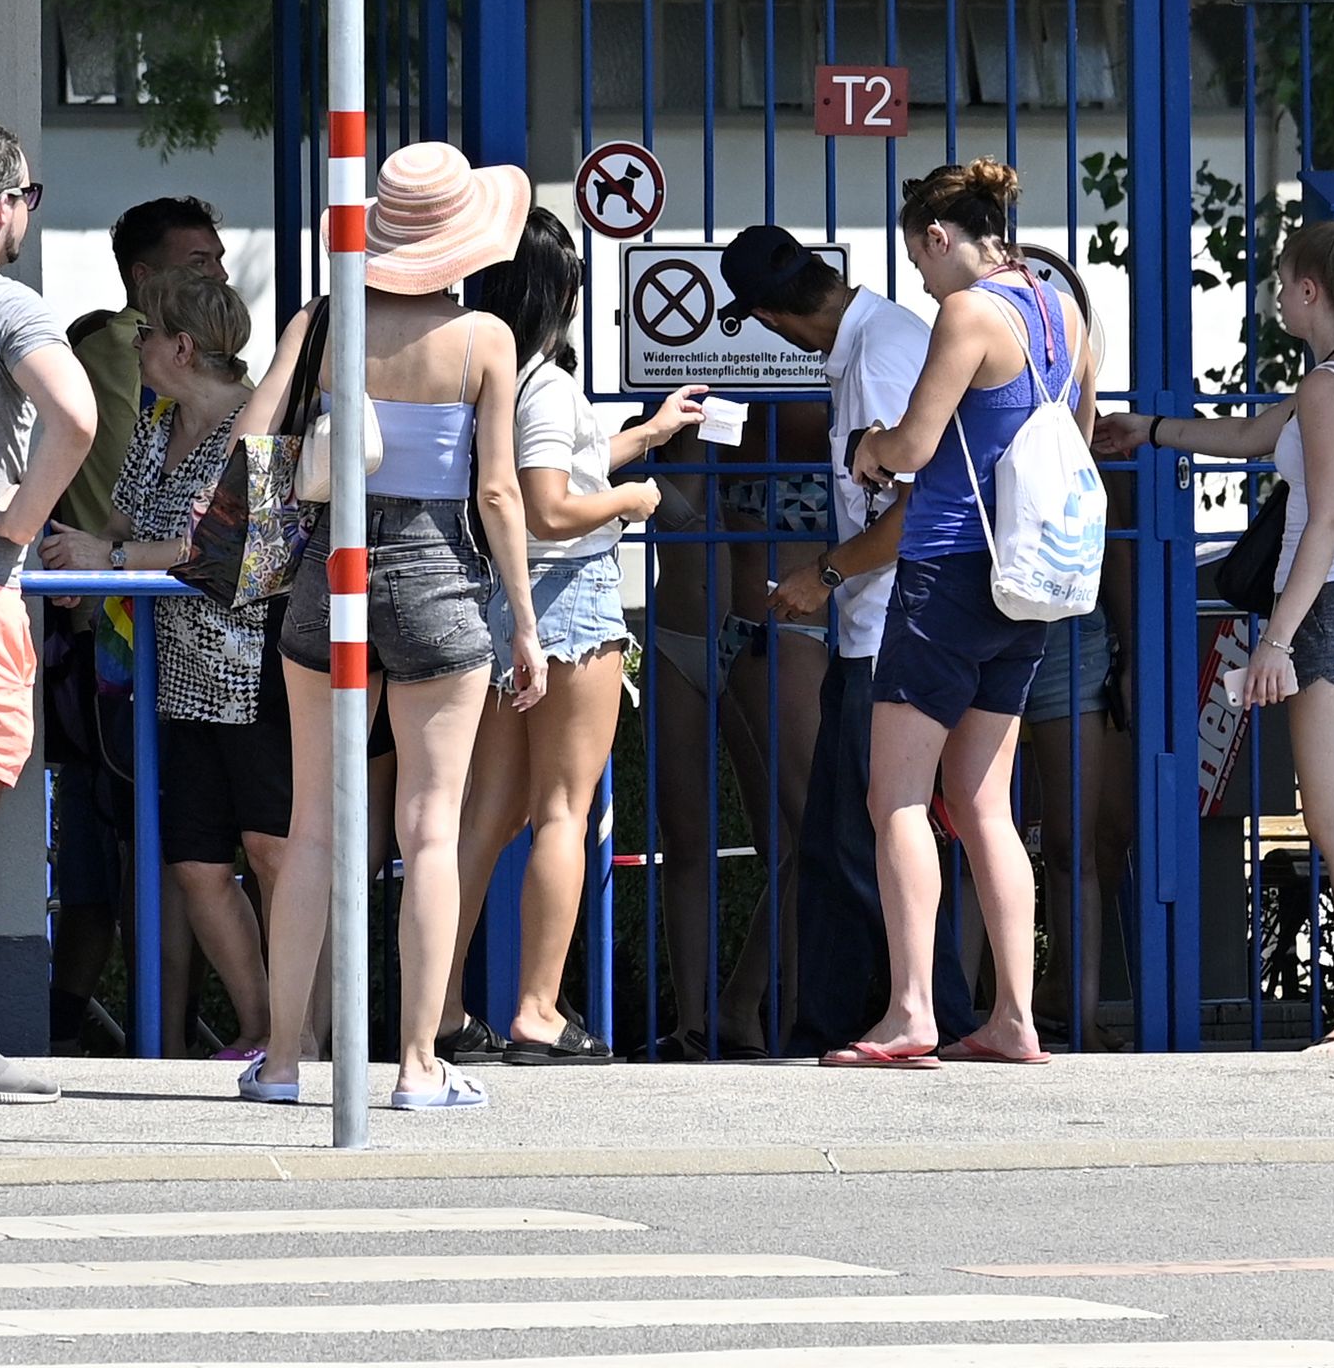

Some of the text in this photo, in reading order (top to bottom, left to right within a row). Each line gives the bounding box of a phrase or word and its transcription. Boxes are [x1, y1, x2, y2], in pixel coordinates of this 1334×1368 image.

[832, 76, 891, 125] T2
[643, 351, 719, 363] Widerrechtlich
[721, 351, 778, 365] abgestellte
[644, 365, 684, 376] werden
[686, 365, 760, 378] kostenpflichtig
